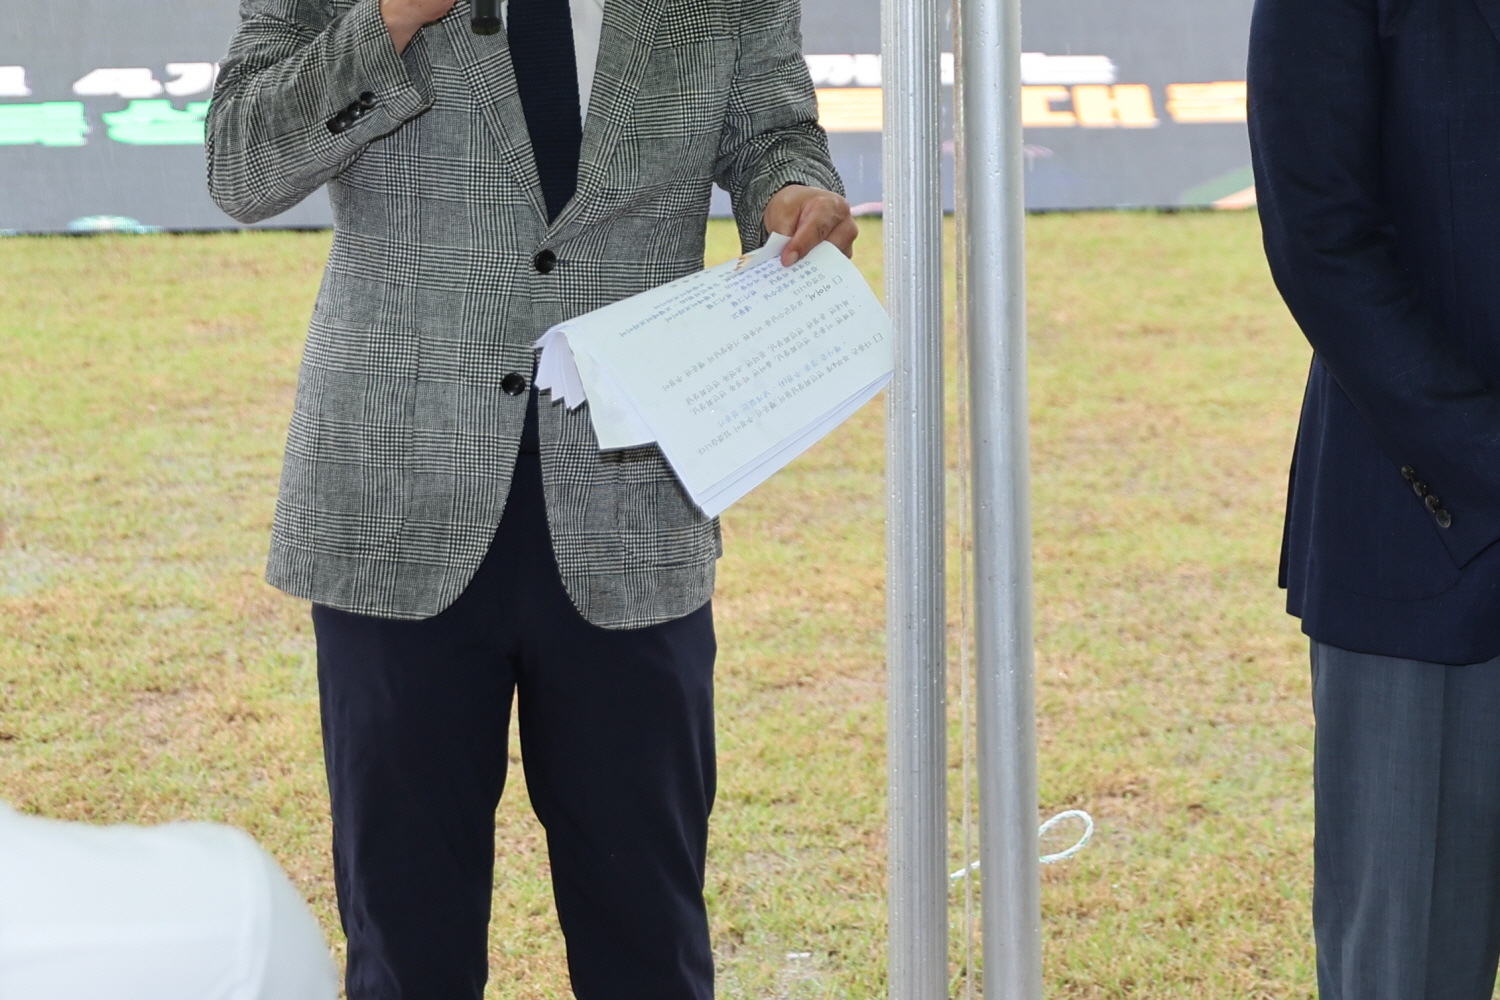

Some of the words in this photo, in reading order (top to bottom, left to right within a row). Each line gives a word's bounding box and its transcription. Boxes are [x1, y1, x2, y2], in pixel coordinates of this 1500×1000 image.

[804, 284, 832, 302] 이어서,
[764, 298, 804, 327] 보성군수님을
[661, 375, 683, 392] 추첨이
[717, 410, 739, 428] 선풍기
[732, 415, 754, 433] 추첨이
[695, 430, 732, 456] 있겠습니다.
